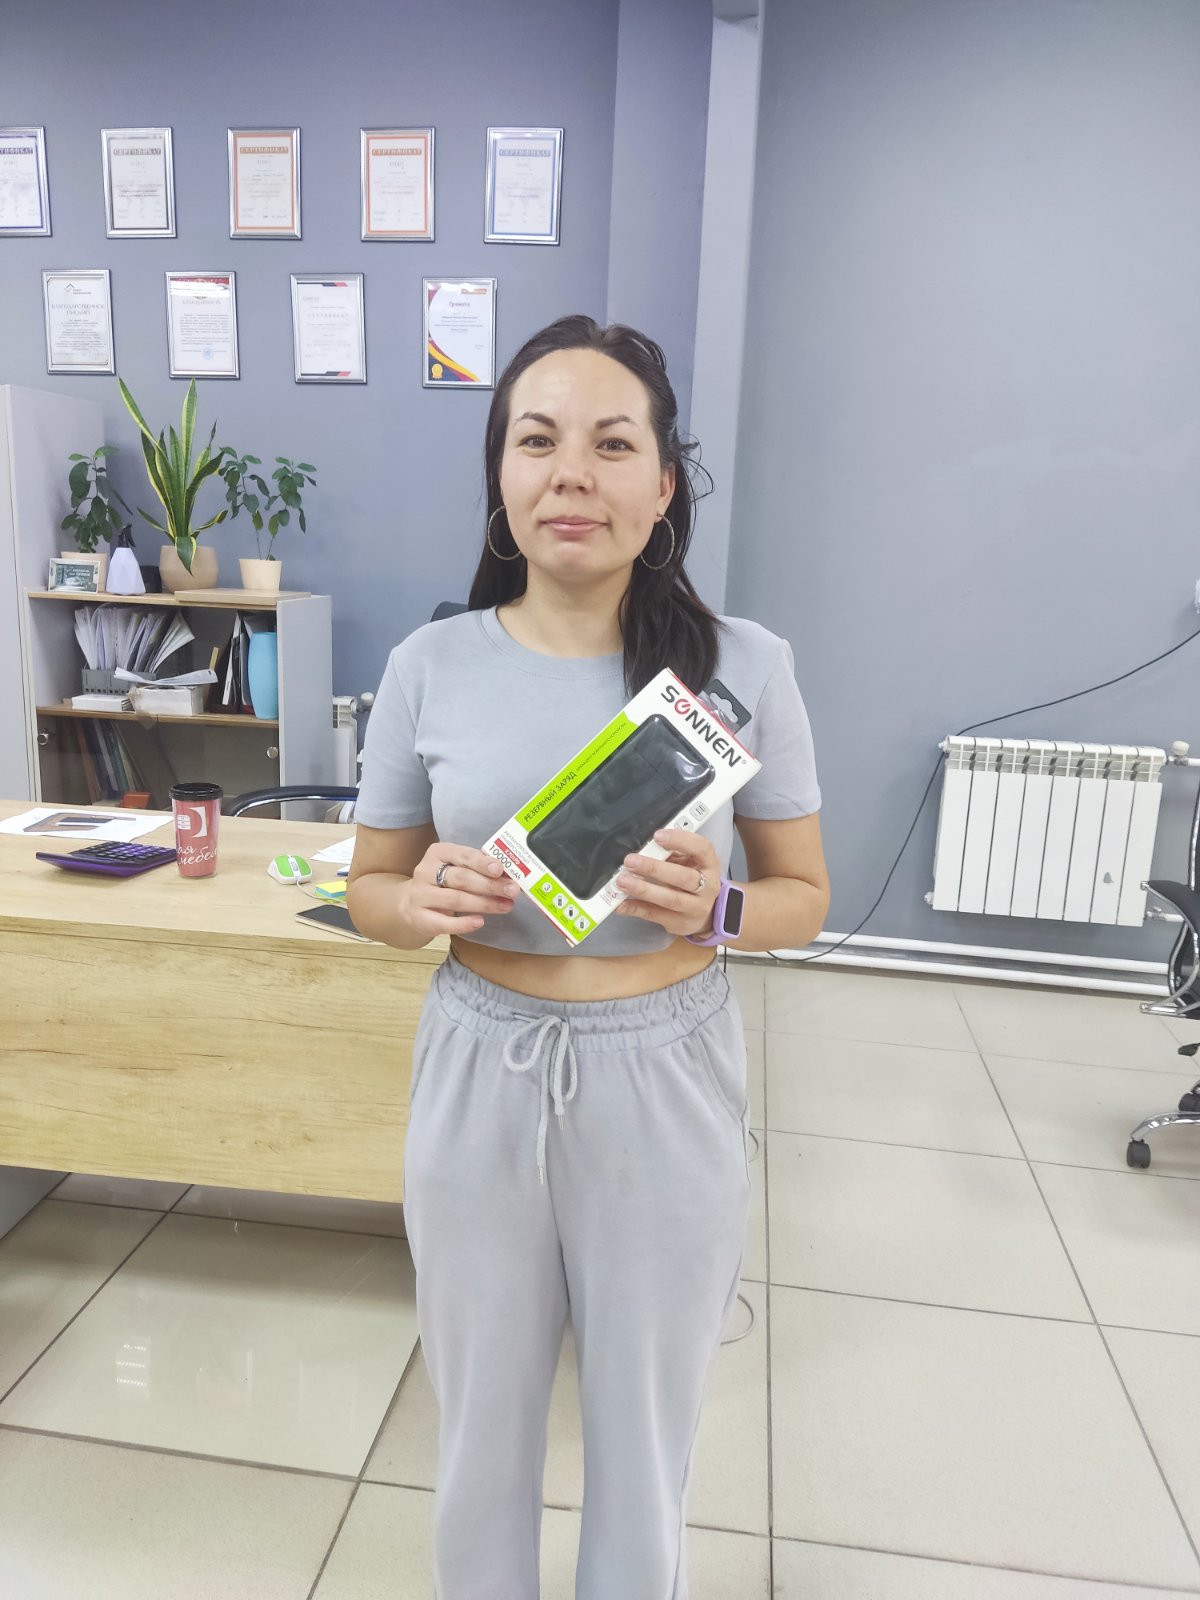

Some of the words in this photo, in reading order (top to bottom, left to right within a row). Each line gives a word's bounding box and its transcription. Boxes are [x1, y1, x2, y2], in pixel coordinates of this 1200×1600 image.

[661, 685, 742, 768] SONNEN
[523, 788, 557, 823] РЕЗЕРВНЫЙ
[556, 771, 577, 792] ЗАРЯД
[489, 844, 512, 869] 10000
